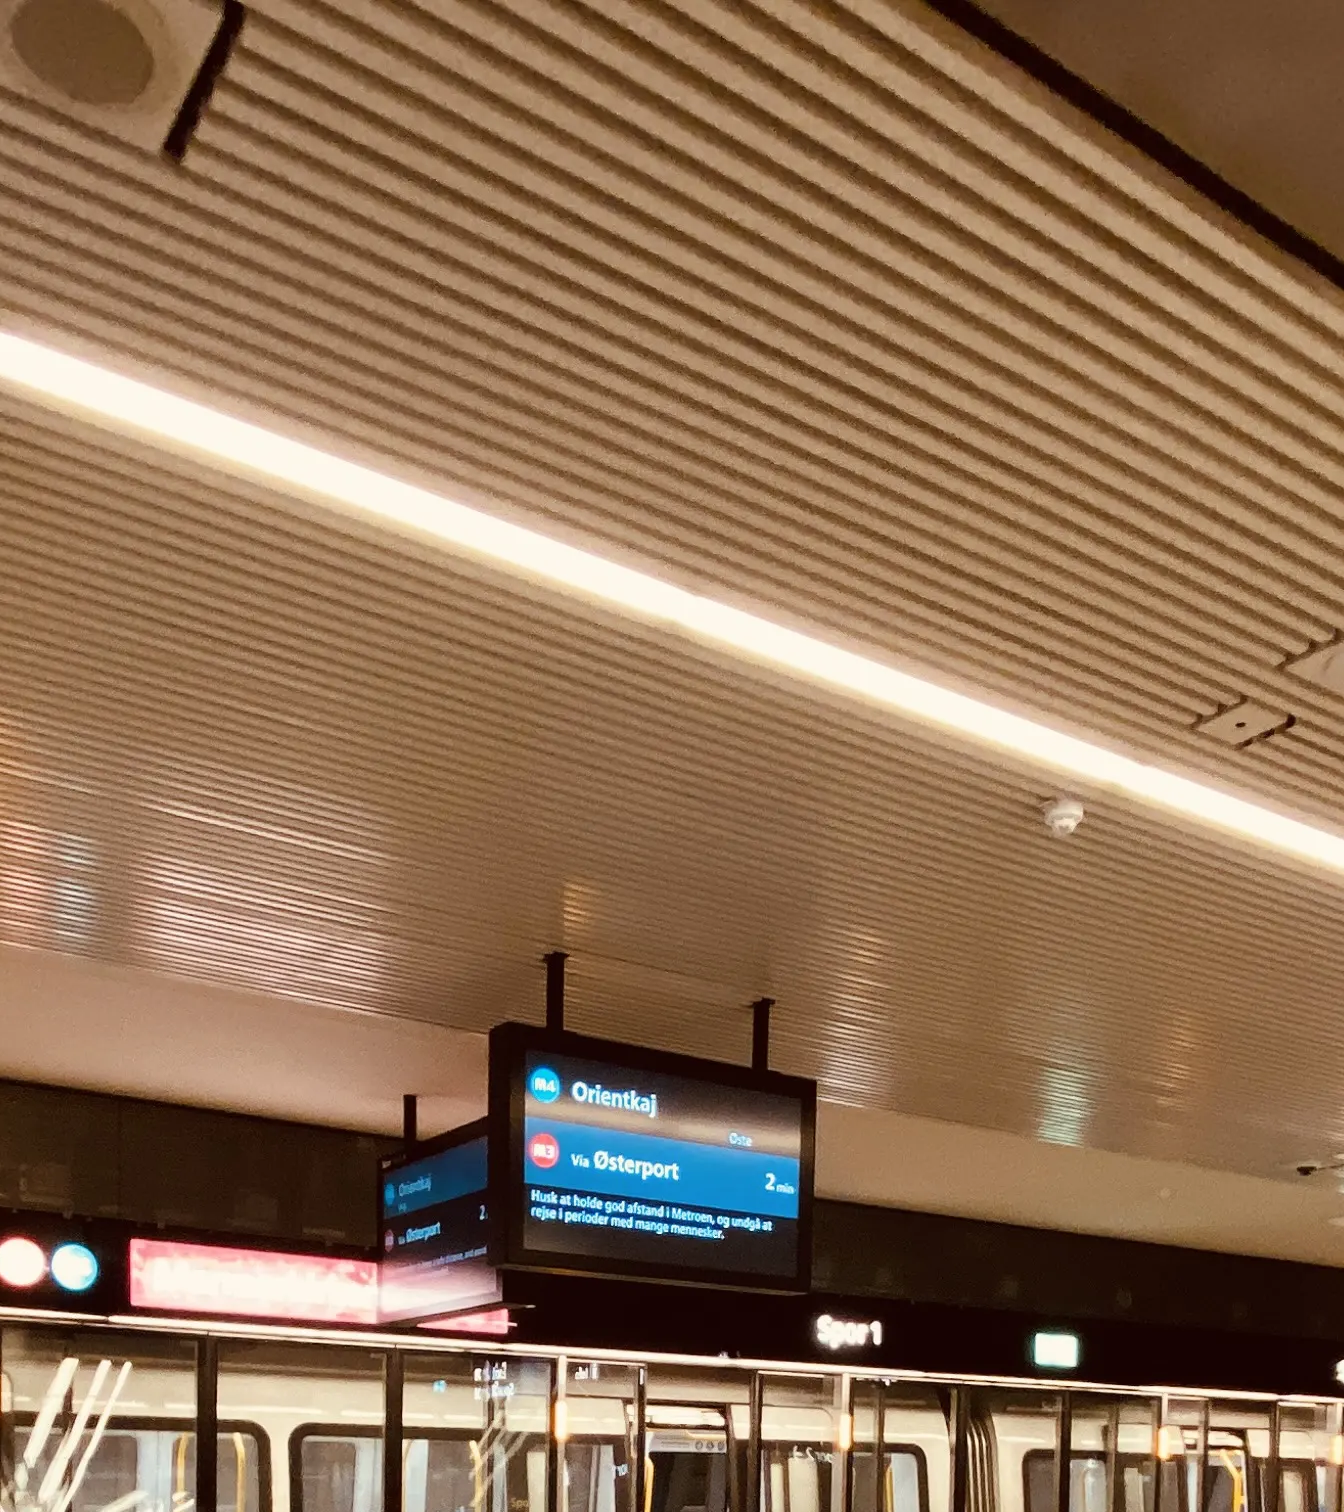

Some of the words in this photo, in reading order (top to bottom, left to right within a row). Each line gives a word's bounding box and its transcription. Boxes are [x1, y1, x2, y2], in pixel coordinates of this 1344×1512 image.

[535, 1077, 556, 1093] M4
[572, 1081, 657, 1118] Orientkaj
[533, 1143, 555, 1159] M3
[571, 1153, 590, 1168] Via
[594, 1150, 680, 1181] Østerport
[764, 1172, 776, 1191] 2
[776, 1182, 795, 1195] min
[530, 1189, 558, 1204] Husk
[559, 1194, 571, 1206] at
[573, 1194, 603, 1210] holde
[604, 1200, 625, 1214] god
[626, 1201, 664, 1218] afstand
[665, 1206, 670, 1219] i
[671, 1207, 715, 1226] Metroen,
[716, 1215, 730, 1229] og
[731, 1216, 761, 1232] undgå
[762, 1220, 773, 1232] at
[530, 1205, 557, 1221] rejse
[558, 1207, 563, 1220] i
[564, 1210, 609, 1225] perioder
[610, 1216, 634, 1229] med
[635, 1220, 669, 1235] mange
[670, 1223, 725, 1240] mennesker.
[816, 1314, 869, 1349] Spor
[869, 1320, 883, 1346] 1
